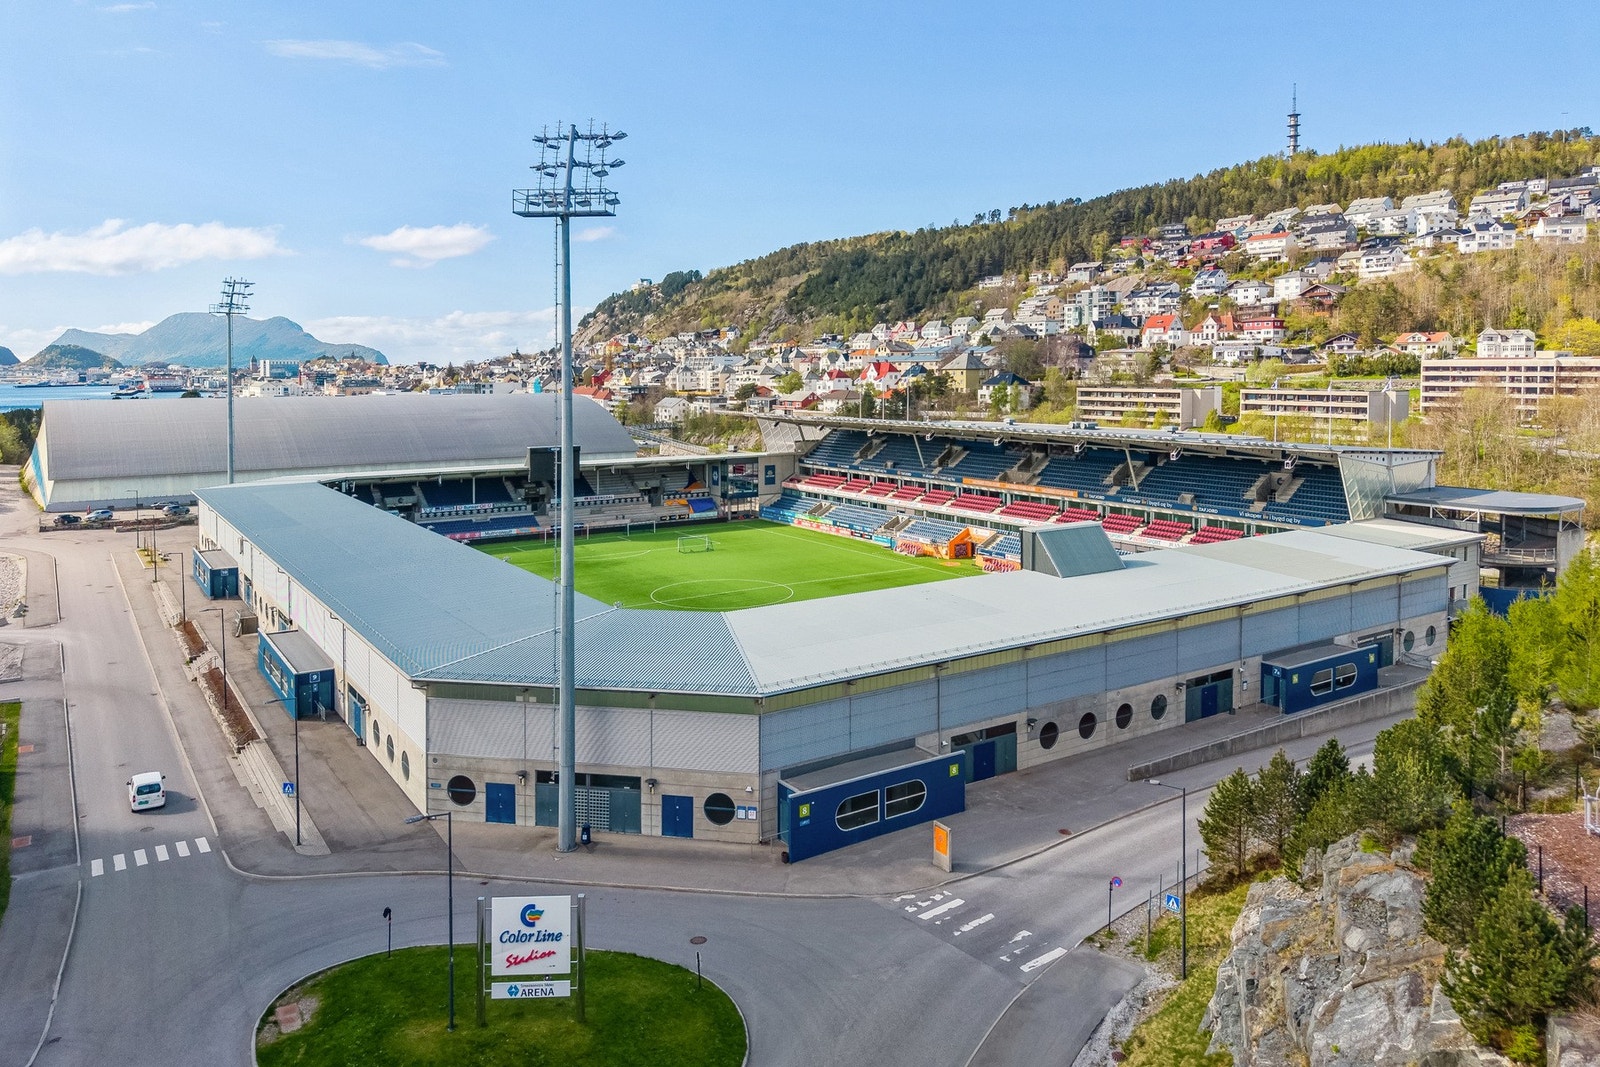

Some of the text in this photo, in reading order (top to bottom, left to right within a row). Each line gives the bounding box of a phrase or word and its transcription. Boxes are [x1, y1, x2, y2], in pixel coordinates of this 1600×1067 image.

[802, 806, 807, 815] 8
[499, 929, 563, 944] Color Line
[505, 949, 556, 969] Stadion
[520, 987, 555, 997] ARENA
